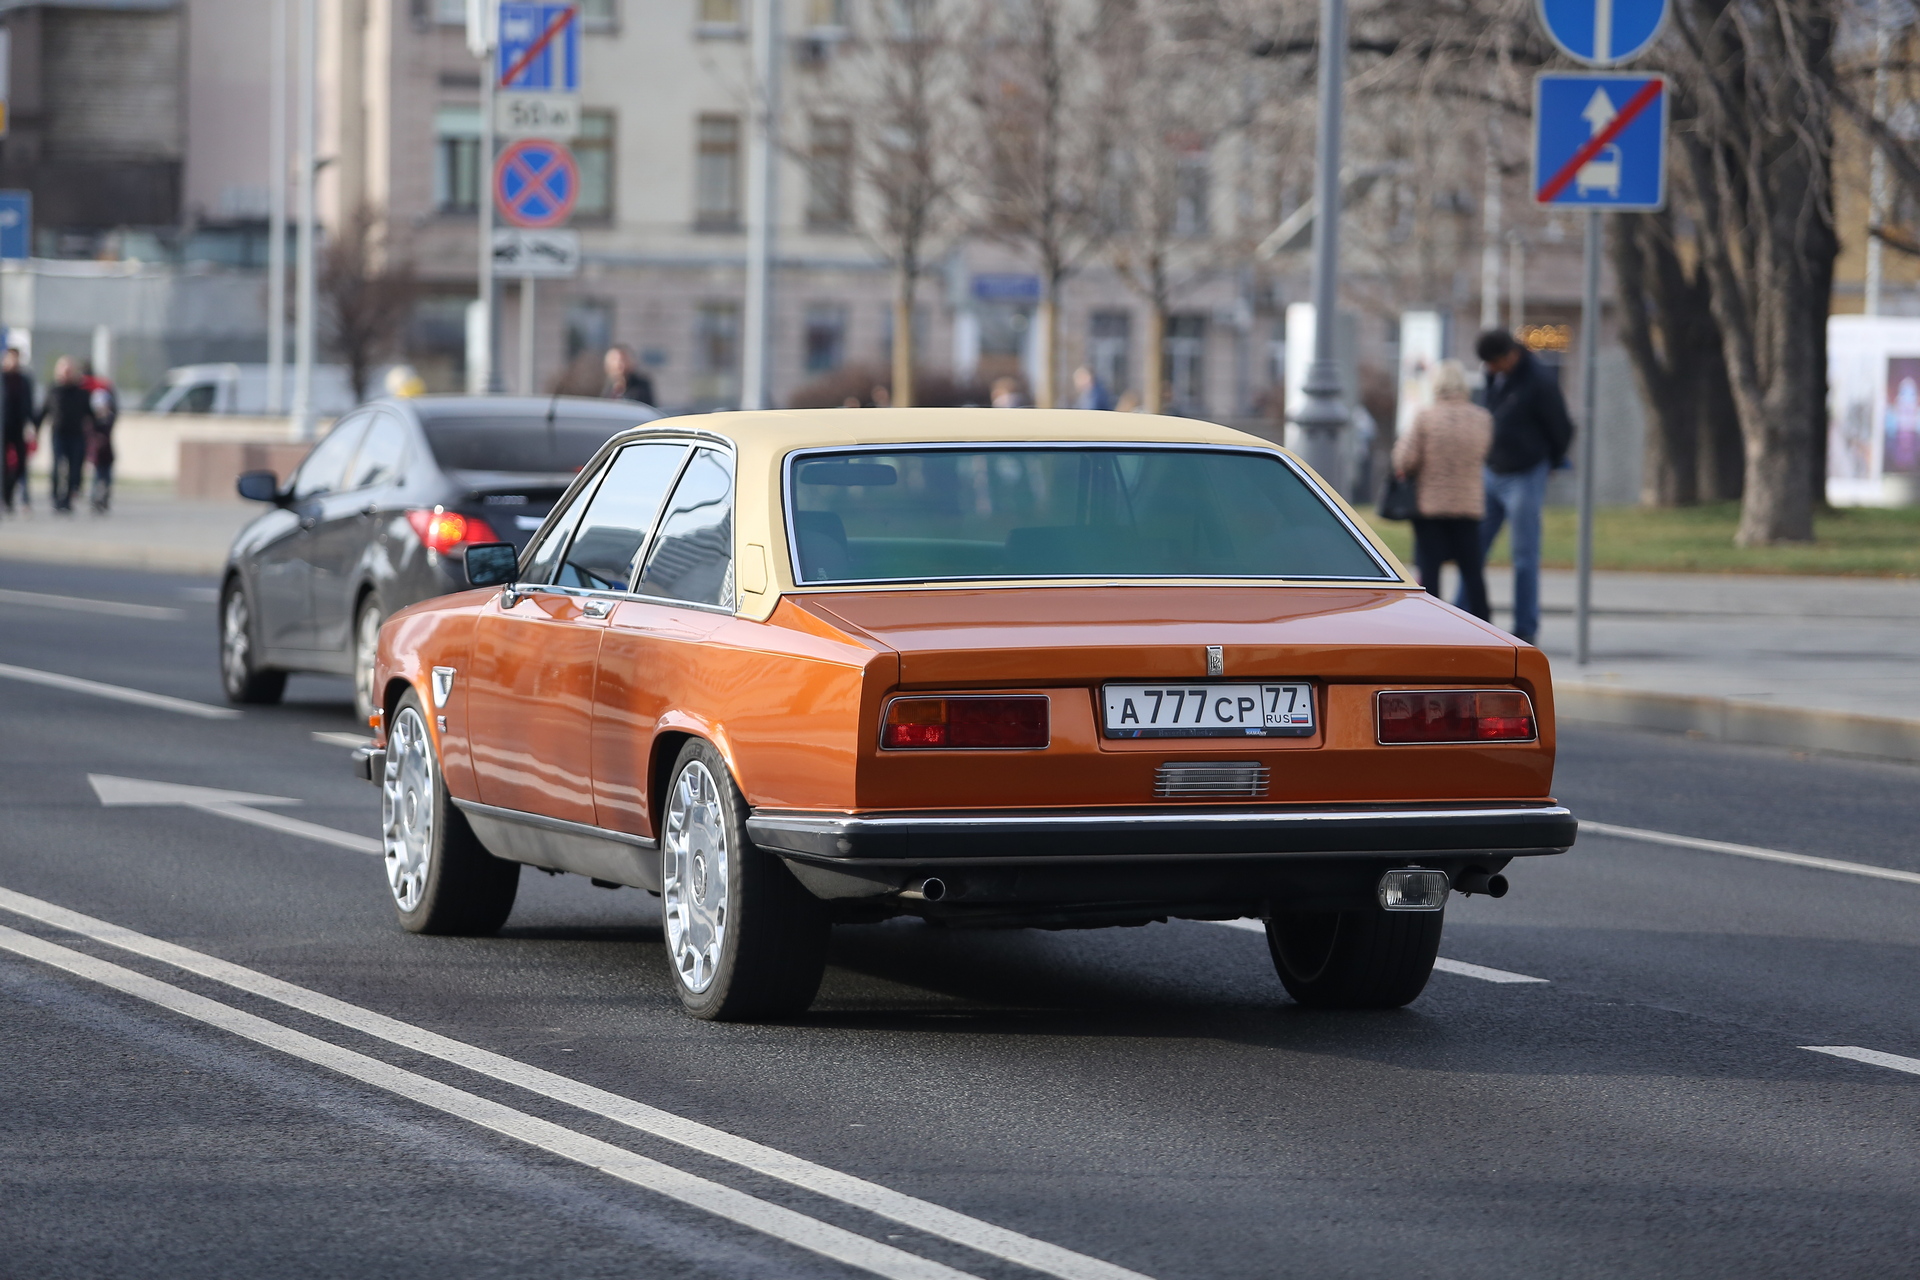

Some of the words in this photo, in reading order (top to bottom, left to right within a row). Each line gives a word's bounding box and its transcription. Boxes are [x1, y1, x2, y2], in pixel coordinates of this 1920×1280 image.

[1120, 690, 1255, 724] А777СР
[1265, 687, 1298, 713] 77
[1266, 714, 1290, 723] RUS
